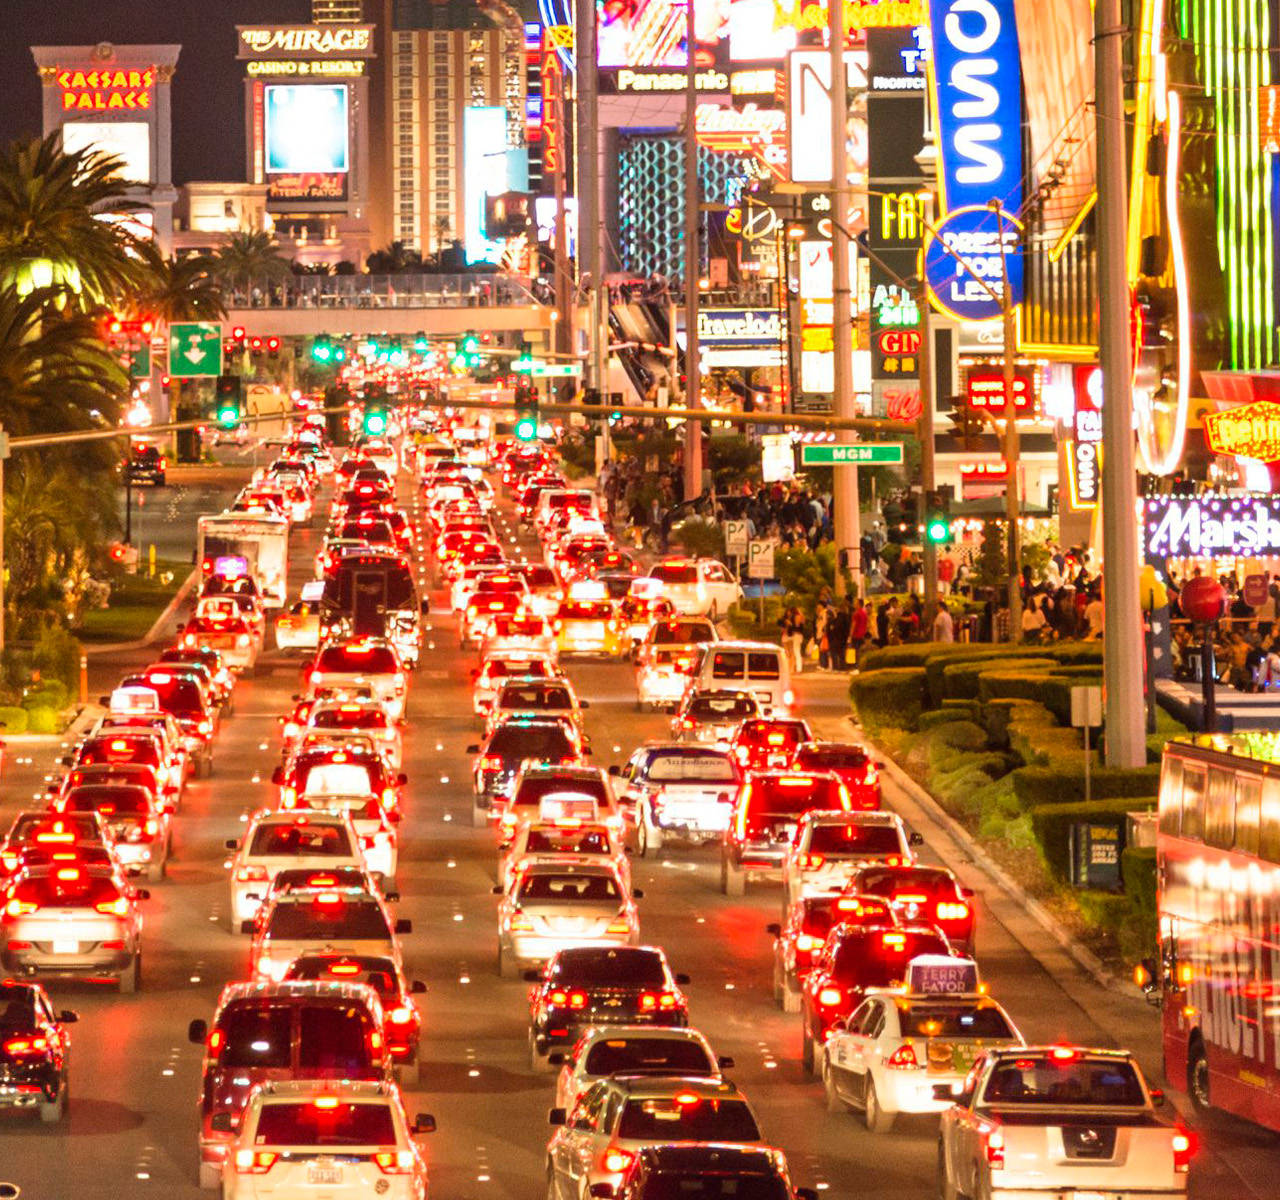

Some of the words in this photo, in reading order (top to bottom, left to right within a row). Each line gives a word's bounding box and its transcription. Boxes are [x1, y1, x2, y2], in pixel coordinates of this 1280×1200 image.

[241, 30, 270, 44] THE
[251, 28, 369, 52] MIRAGE
[246, 61, 297, 75] CASINO
[311, 60, 365, 75] RESORT
[57, 70, 154, 89] CAESARS
[617, 69, 729, 91] Panasnic
[63, 91, 151, 110] PALACE
[831, 448, 874, 460] MGM
[921, 968, 968, 981] TERRY
